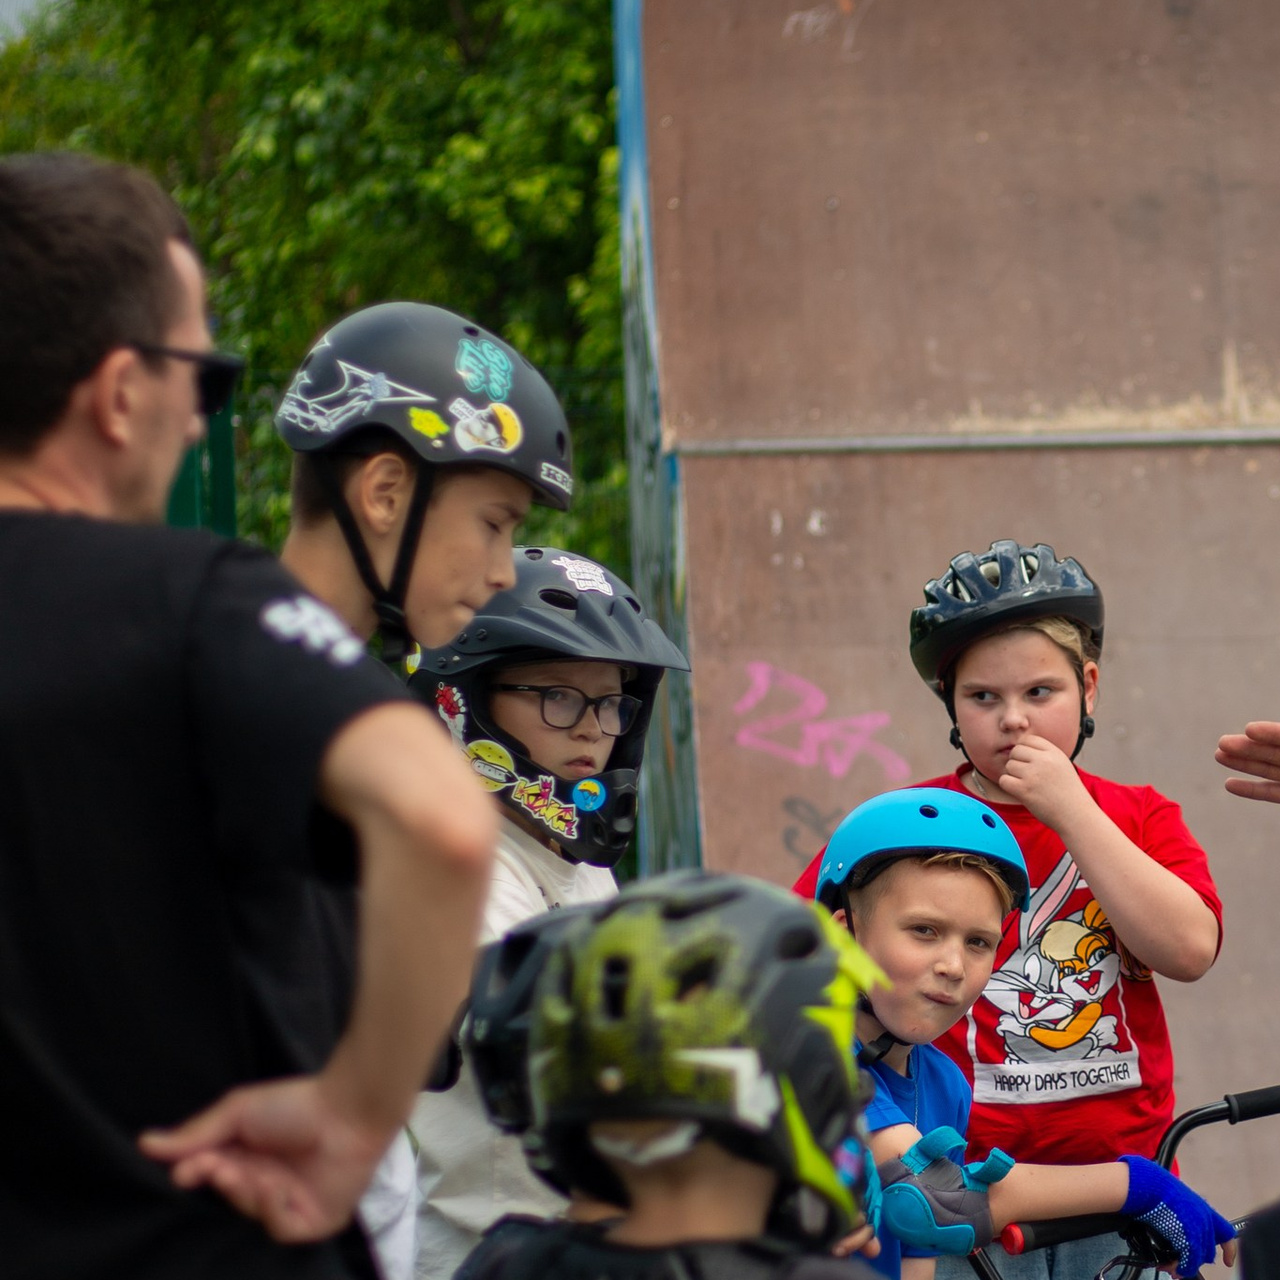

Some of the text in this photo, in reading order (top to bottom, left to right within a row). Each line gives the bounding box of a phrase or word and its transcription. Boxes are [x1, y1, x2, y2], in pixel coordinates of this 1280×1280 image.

[993, 1062, 1131, 1092] HAPPY DAYS TOGETHER
